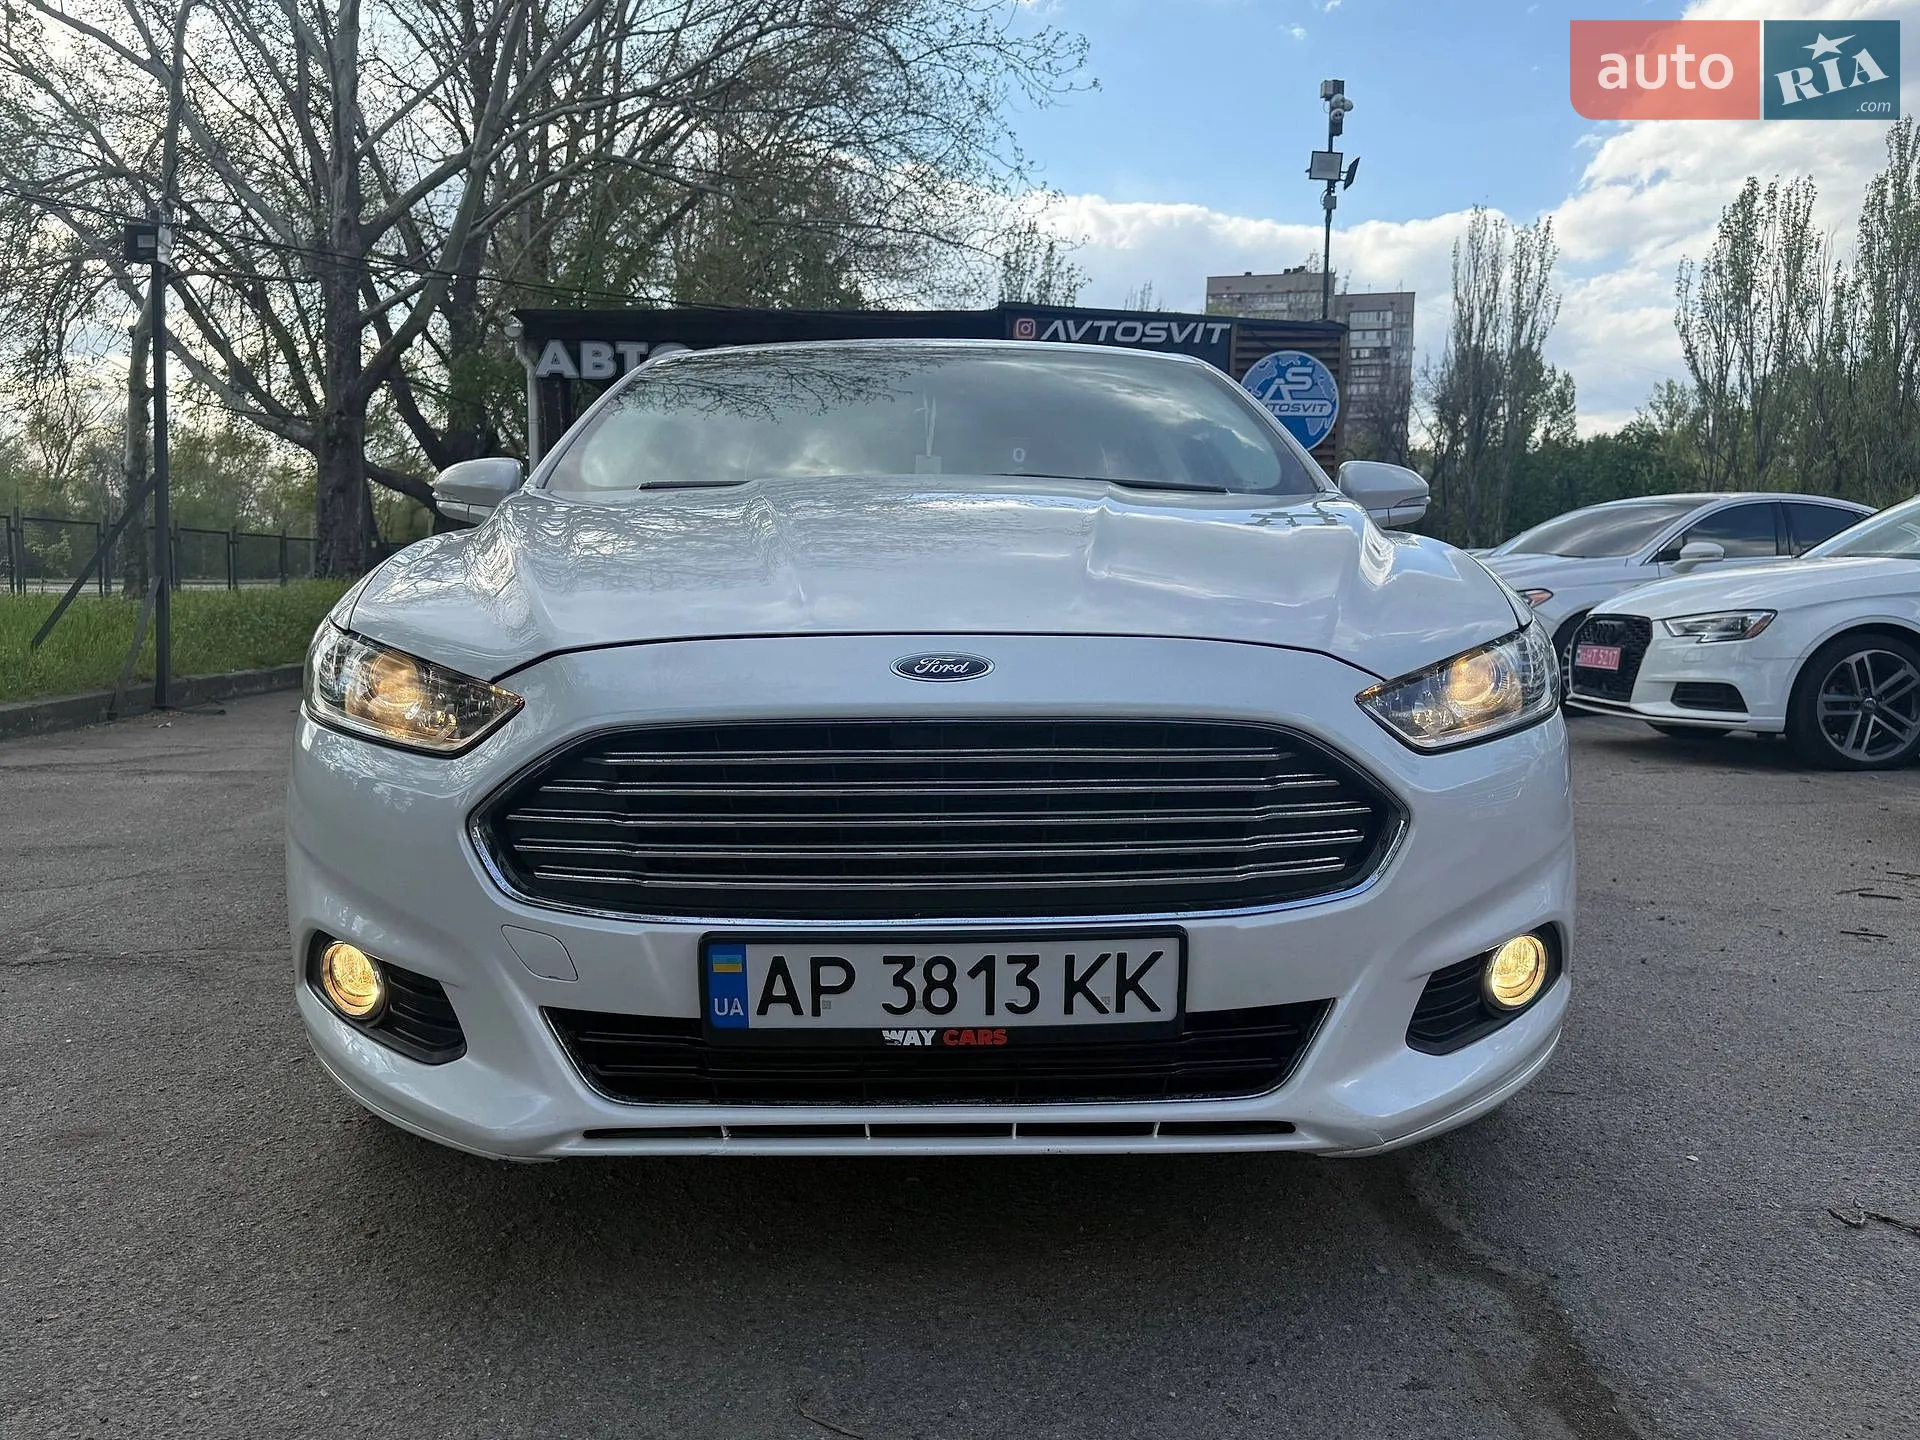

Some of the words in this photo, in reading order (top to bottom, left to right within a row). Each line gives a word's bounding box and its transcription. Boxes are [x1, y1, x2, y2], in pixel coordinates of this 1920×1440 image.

[1040, 319, 1231, 344] AVTOSVIT
[535, 339, 695, 379] АВТ
[914, 657, 970, 674] Ford
[756, 955, 856, 1017] AP
[881, 954, 1041, 1016] 3813
[1063, 951, 1164, 1015] KK
[713, 997, 744, 1018] UA
[881, 1029, 937, 1046] WAY
[942, 1029, 1008, 1046] CARS
